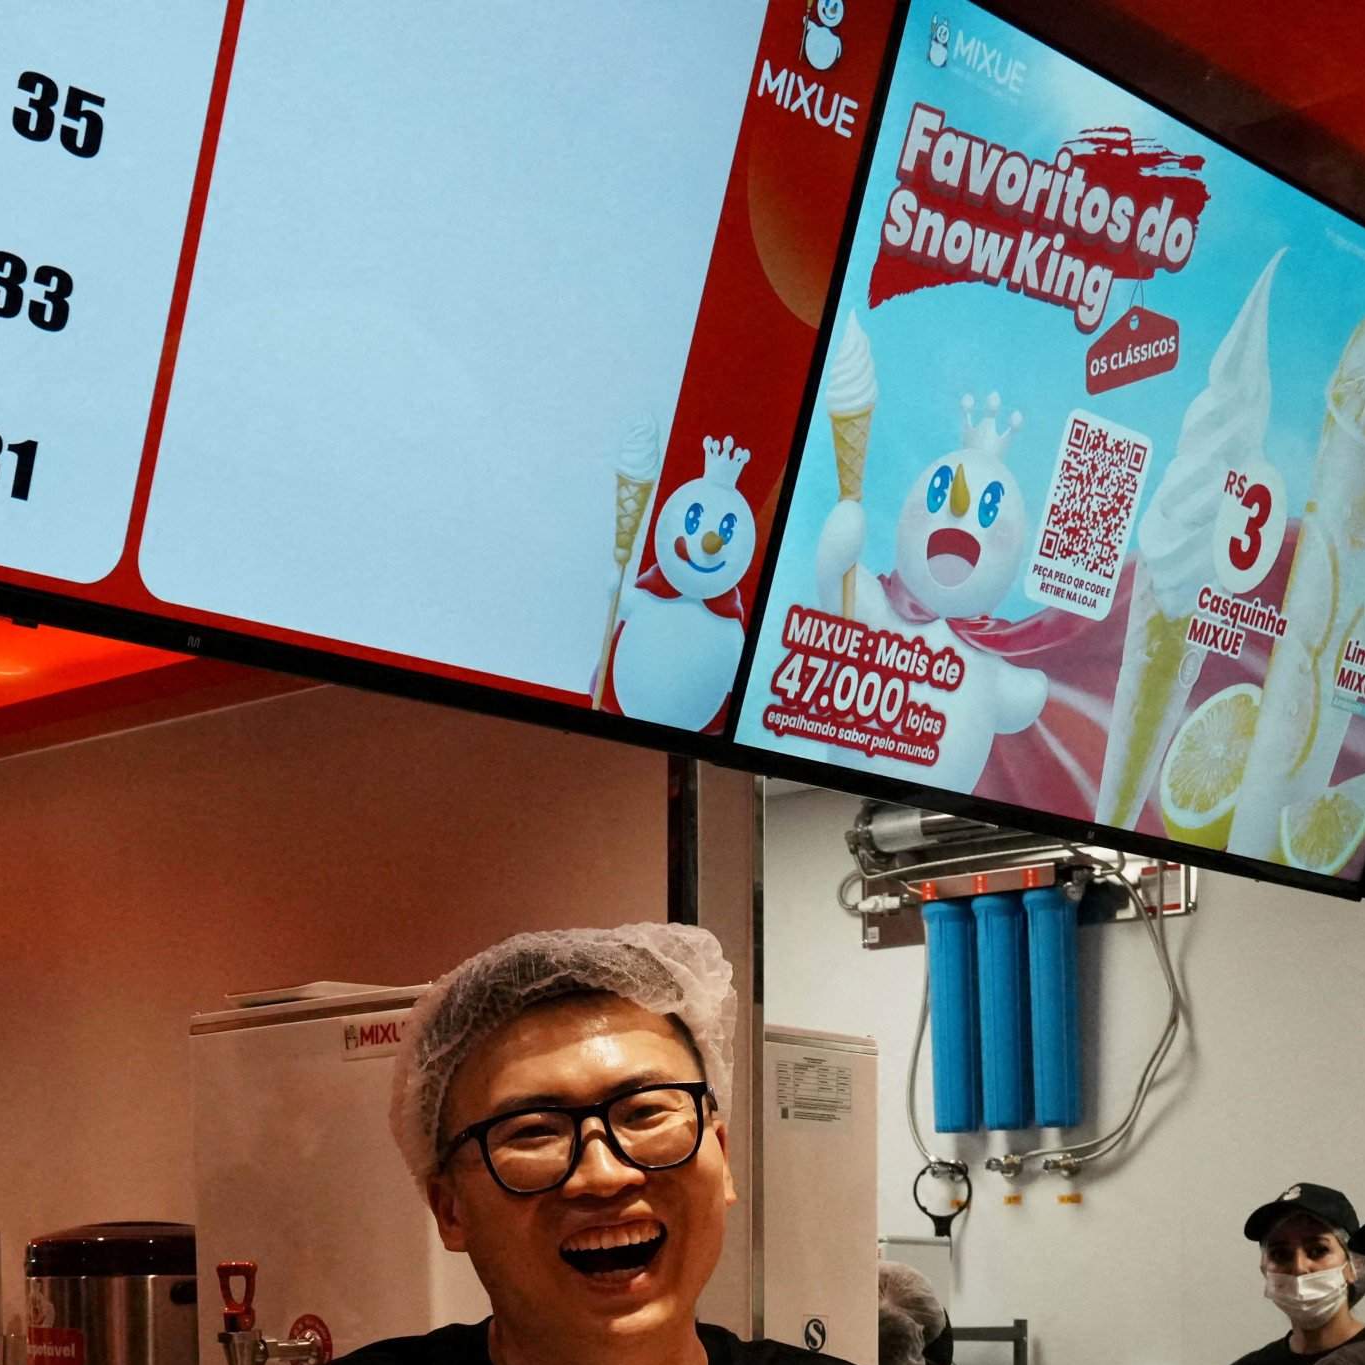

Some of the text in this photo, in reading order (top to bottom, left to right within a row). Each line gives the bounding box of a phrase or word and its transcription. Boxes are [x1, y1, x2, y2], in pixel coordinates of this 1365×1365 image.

[953, 30, 1026, 93] MIXUE
[12, 70, 106, 158] 35
[757, 59, 859, 139] MIXUE
[902, 106, 1195, 264] Favoritos do
[885, 190, 1113, 327] Snow King
[1089, 334, 1177, 377] OS CLÁSSICOS
[1224, 470, 1272, 571] R$ 3
[1032, 564, 1053, 581] PEÇA
[1054, 570, 1073, 585] PELO
[1074, 578, 1085, 589] QR
[1085, 581, 1105, 598] CODE
[1039, 582, 1097, 608] RETIRE NA LOJA
[1198, 587, 1288, 637] Casquinha
[787, 612, 864, 658] MIXUE
[875, 637, 929, 677] Mais
[932, 654, 961, 684] de
[1187, 618, 1243, 655] MIXUE
[776, 653, 942, 736] 47.000 lojas
[767, 711, 935, 760] espalhando sabor pelo mundo
